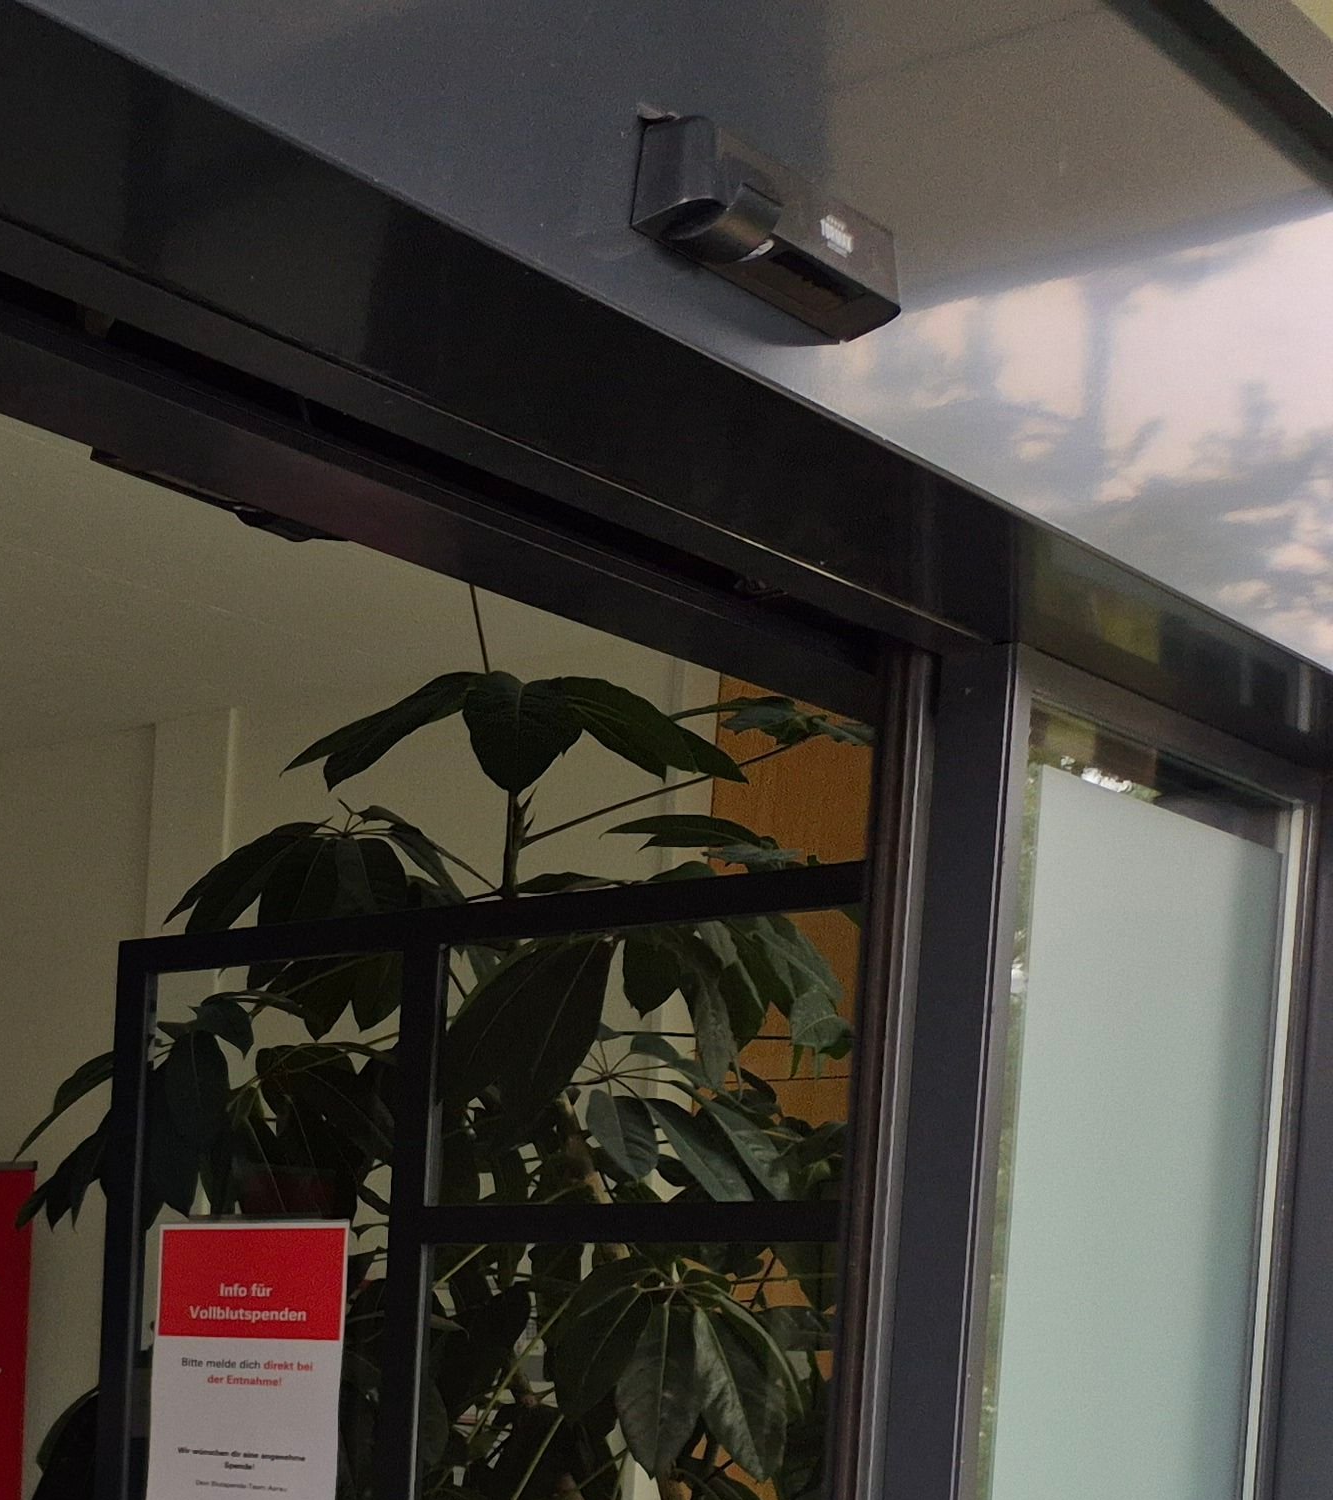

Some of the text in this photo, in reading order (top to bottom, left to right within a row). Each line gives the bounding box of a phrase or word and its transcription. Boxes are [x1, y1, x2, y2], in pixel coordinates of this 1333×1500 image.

[219, 1283, 273, 1297] Info für
[189, 1305, 307, 1323] Vollblutspenden
[181, 1357, 313, 1372] Bitte melde dich direkt bei
[207, 1375, 282, 1387] der Entnahme!
